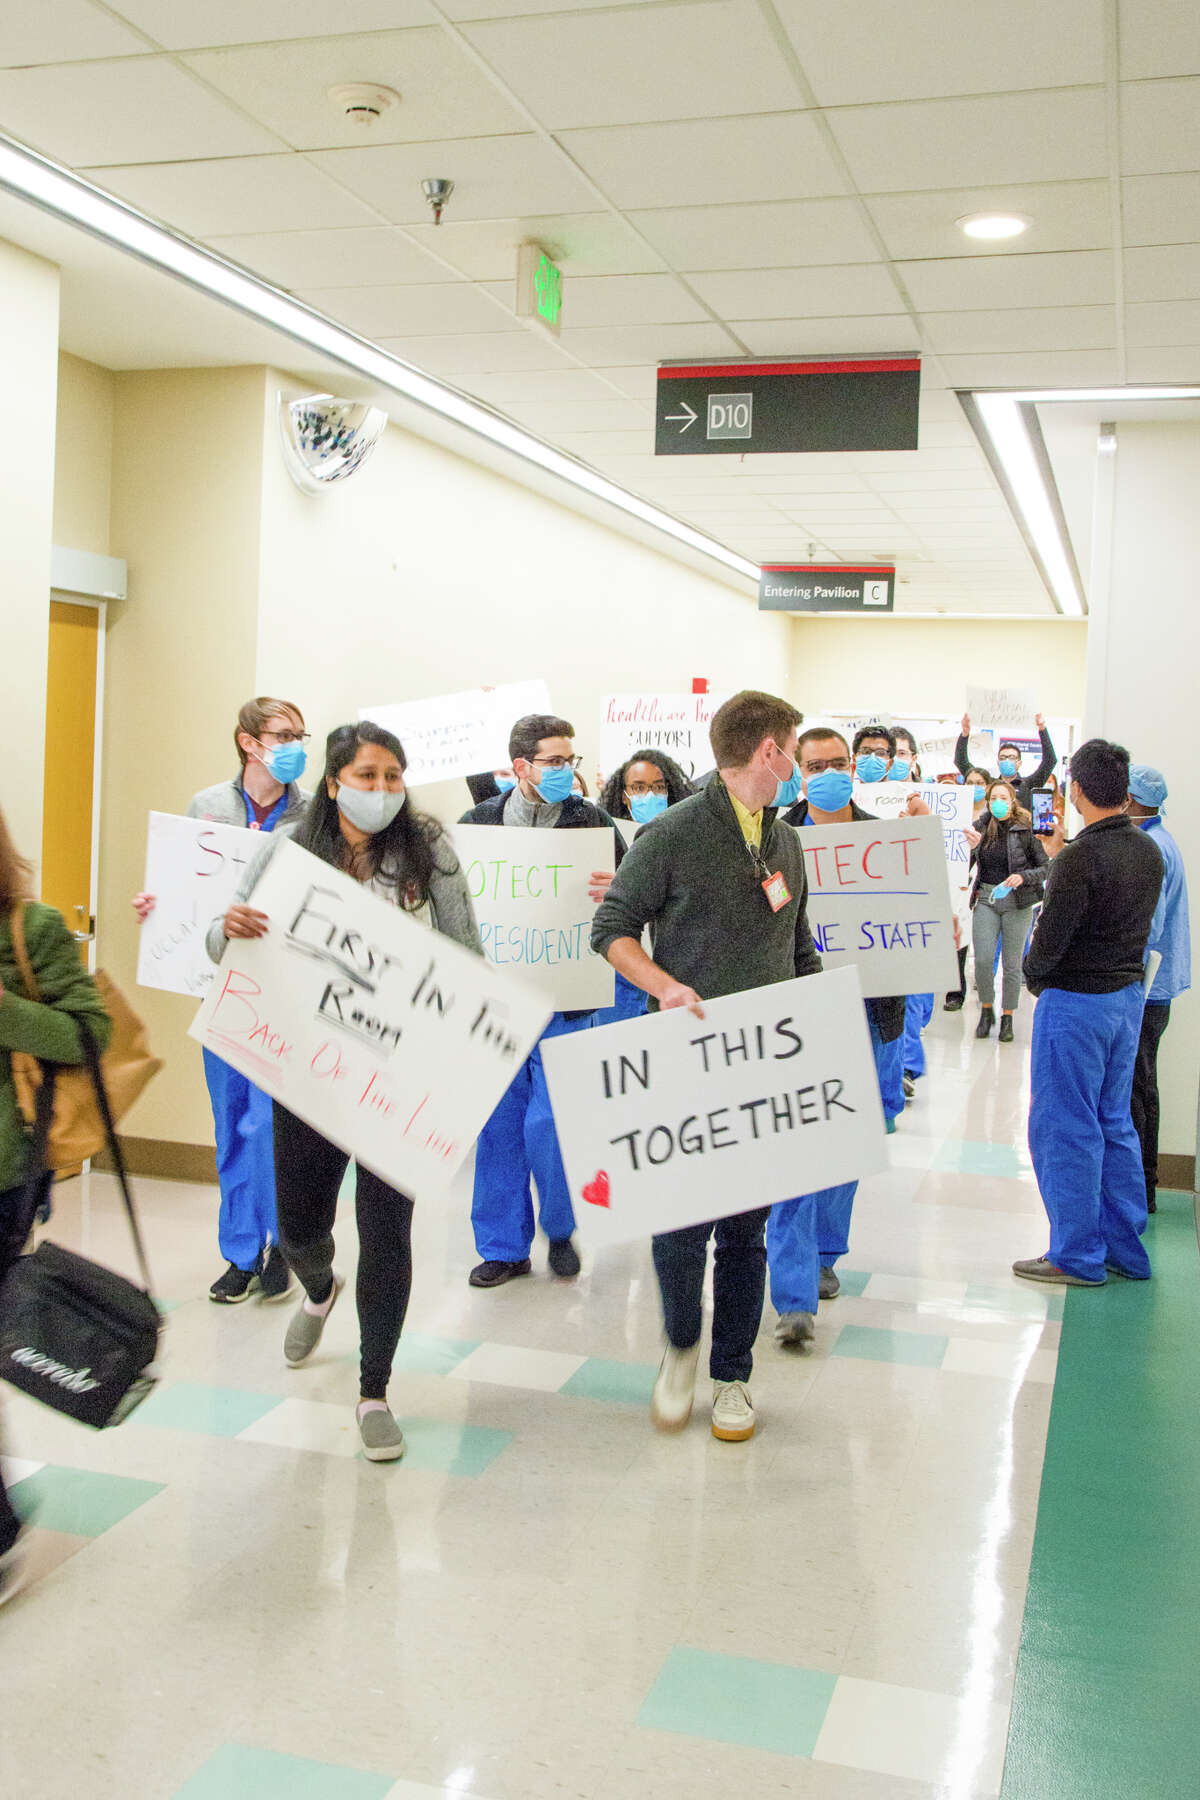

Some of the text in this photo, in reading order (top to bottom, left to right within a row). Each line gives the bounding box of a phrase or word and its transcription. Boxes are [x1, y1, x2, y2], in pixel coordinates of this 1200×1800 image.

[711, 403, 748, 429] D10
[764, 585, 880, 601] Entering Pavilion C
[606, 698, 686, 724] healthcare
[465, 859, 577, 900] OTECT
[803, 837, 921, 887] TECT
[811, 920, 941, 953] NE STAFF
[412, 961, 455, 1017] IN
[207, 969, 294, 1061] BACK
[601, 1016, 804, 1099] IN THIS
[609, 1078, 857, 1170] TOGETHER
